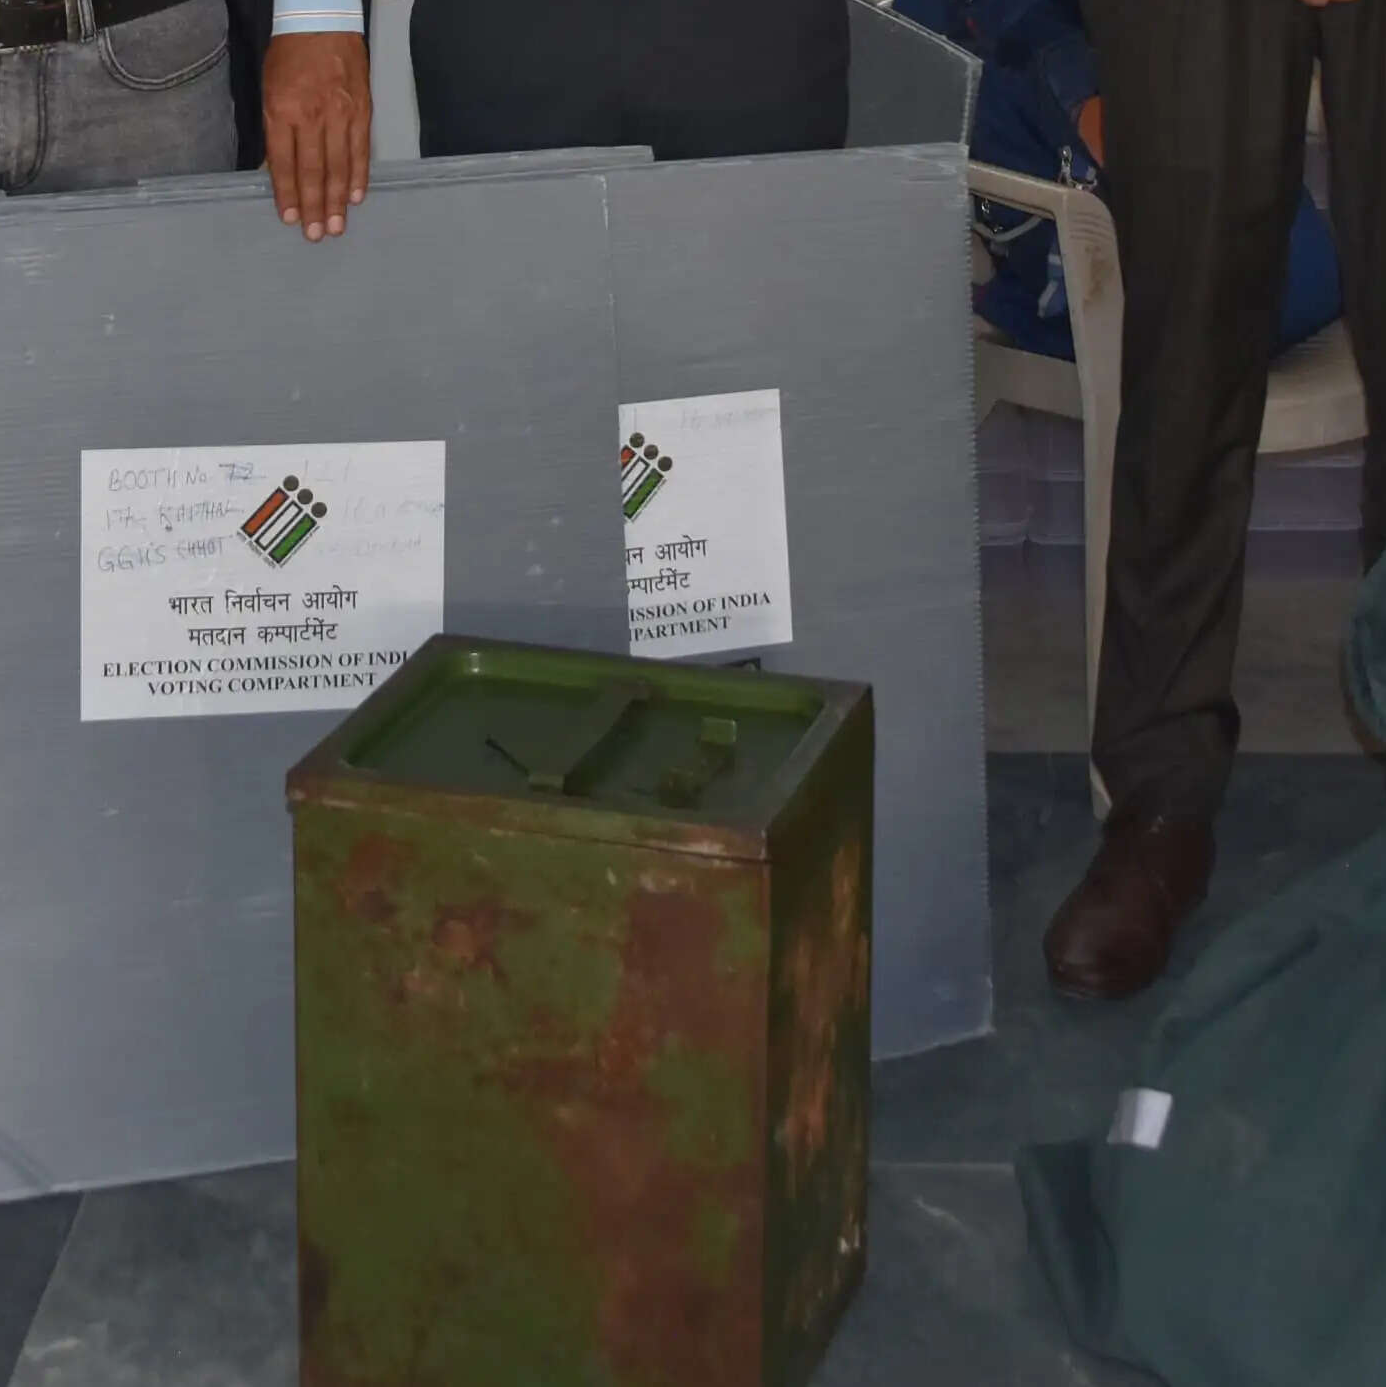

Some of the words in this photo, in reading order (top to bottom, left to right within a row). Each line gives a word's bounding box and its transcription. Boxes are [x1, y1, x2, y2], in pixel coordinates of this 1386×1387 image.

[108, 468, 177, 491] BOOTH
[654, 535, 708, 562] आयोग
[627, 567, 692, 595] म्पार्टमेंट
[168, 594, 215, 616] भारत
[223, 586, 292, 614] निर्वाचन
[301, 585, 359, 612] आयोग
[629, 600, 688, 623] ISSION
[692, 597, 717, 614] OF
[720, 591, 772, 612] INDIA
[187, 625, 247, 647] मतदान
[256, 617, 339, 645] कम्पार्टमेंट
[102, 659, 203, 679] ELECTION
[207, 653, 334, 673] COMMISSION
[338, 653, 364, 668] OF
[368, 650, 410, 667] INDI
[147, 677, 223, 697] VOTING
[226, 671, 379, 694] COMPARTMENT
